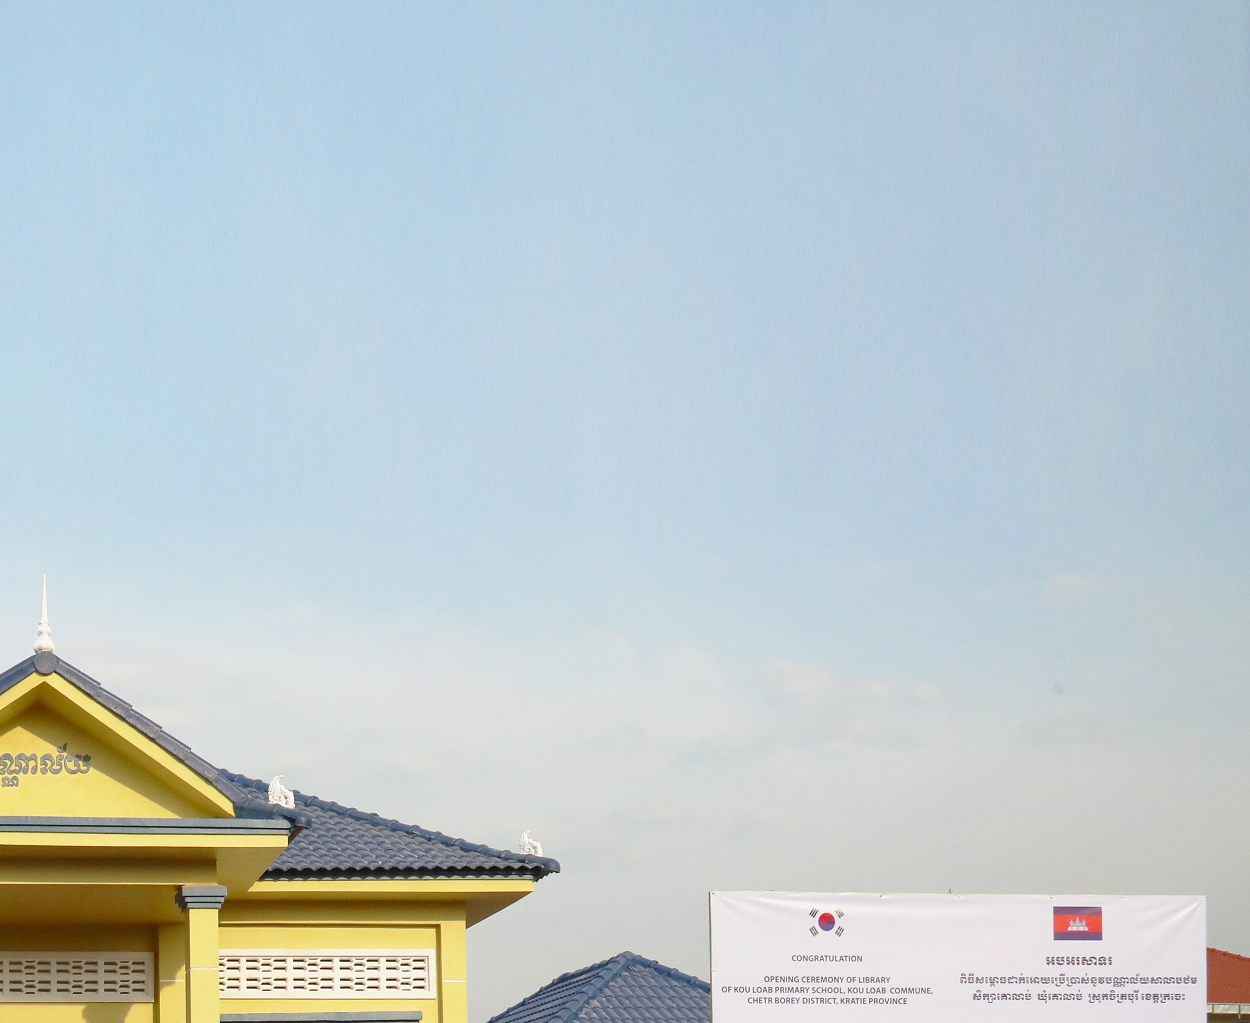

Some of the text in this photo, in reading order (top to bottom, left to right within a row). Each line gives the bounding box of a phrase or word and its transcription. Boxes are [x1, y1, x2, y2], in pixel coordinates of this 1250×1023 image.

[791, 954, 863, 963] CONGRATULATION
[1045, 956, 1113, 966] អបអរសាទរ
[763, 975, 891, 984] OPENING CEREMONY OF LIBRARY
[721, 986, 933, 995] OF KOU LOAB PRIMARY SCHOOL, KOU LOAB COMMUNE,
[747, 997, 908, 1006] CHETR BOREY DISTRICT, KRATIE PROVINCE
